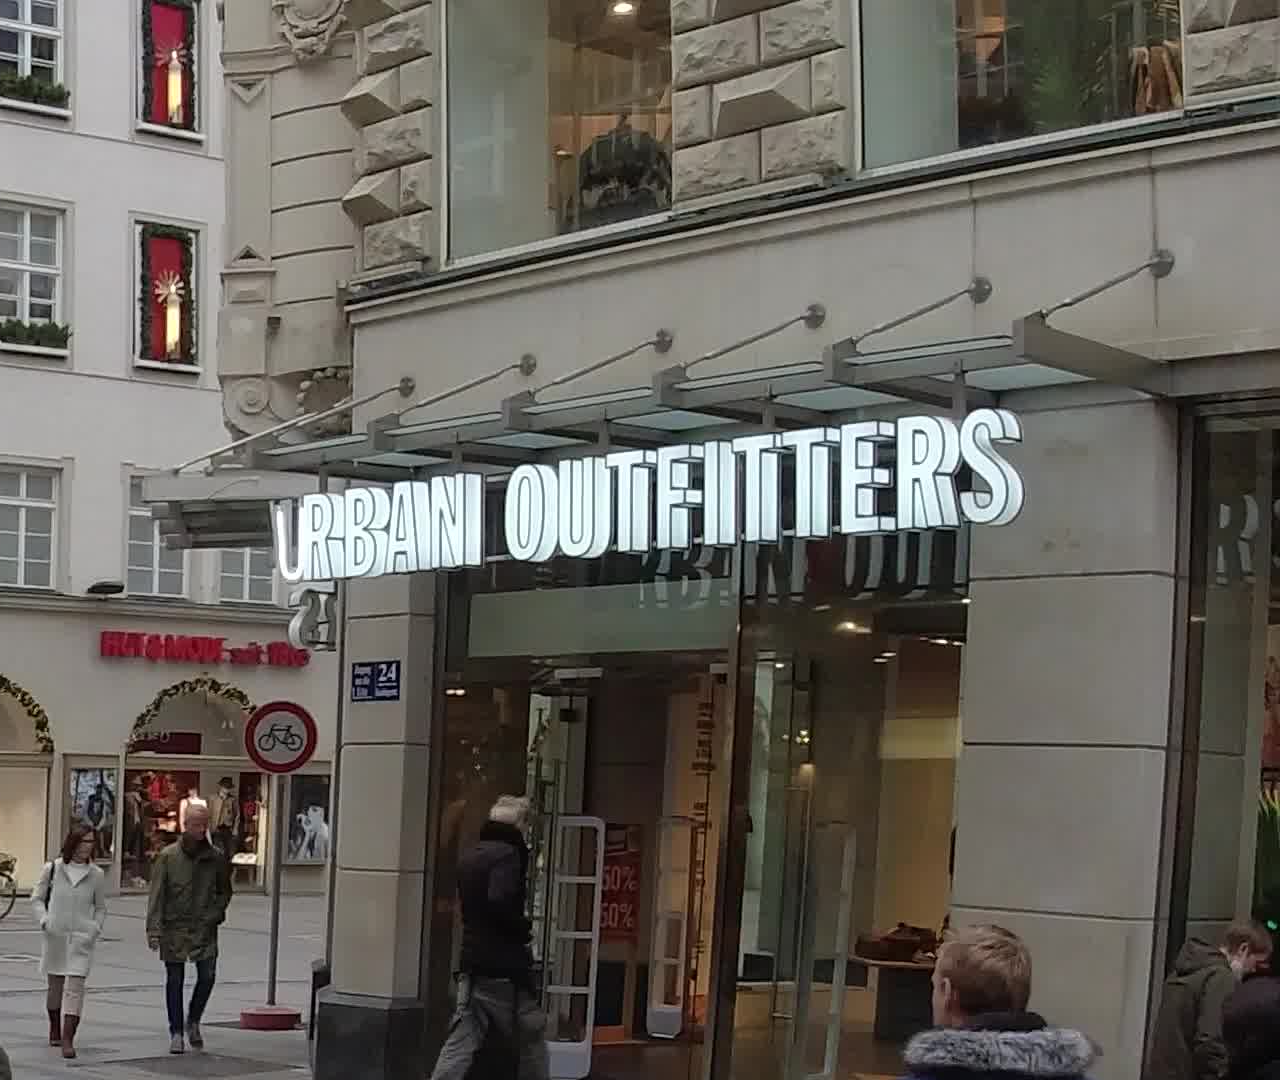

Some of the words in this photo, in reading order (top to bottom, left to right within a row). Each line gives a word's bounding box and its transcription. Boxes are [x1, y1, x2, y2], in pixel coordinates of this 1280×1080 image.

[275, 472, 486, 581] URBAN
[504, 408, 1026, 563] OUTFITTERS
[378, 663, 396, 681] 24
